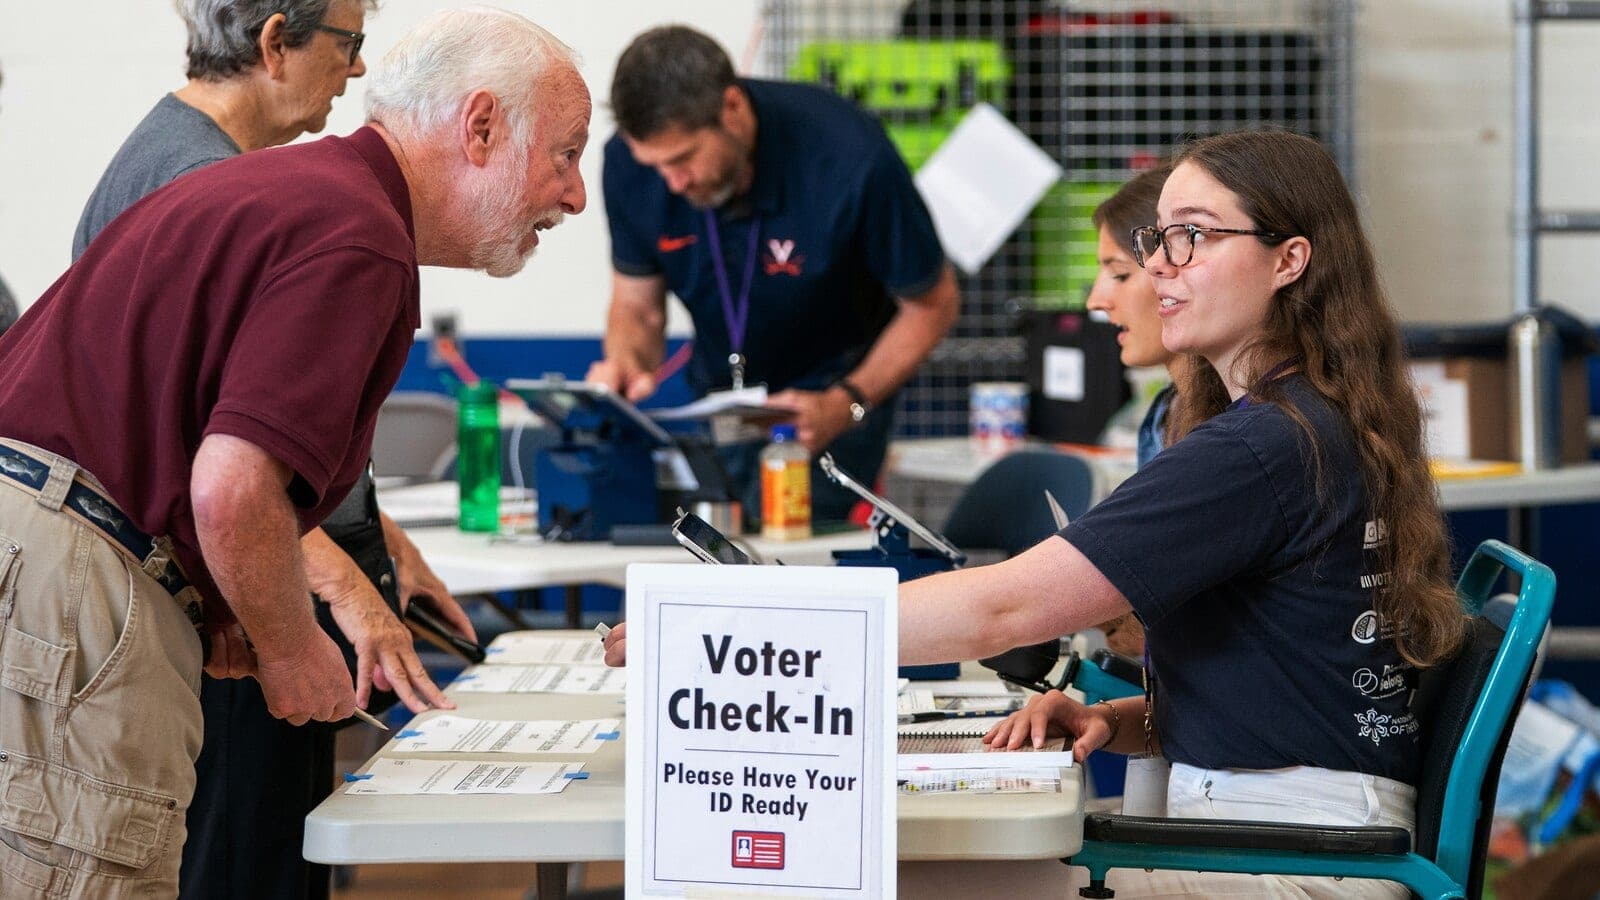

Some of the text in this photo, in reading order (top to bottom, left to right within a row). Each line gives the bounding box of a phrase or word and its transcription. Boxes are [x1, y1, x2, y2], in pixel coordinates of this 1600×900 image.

[702, 634, 822, 678] Voter
[668, 687, 854, 736] Check-In
[1389, 725, 1405, 735] OF
[664, 762, 857, 791] Please Have Your
[710, 791, 809, 822] ID Ready
